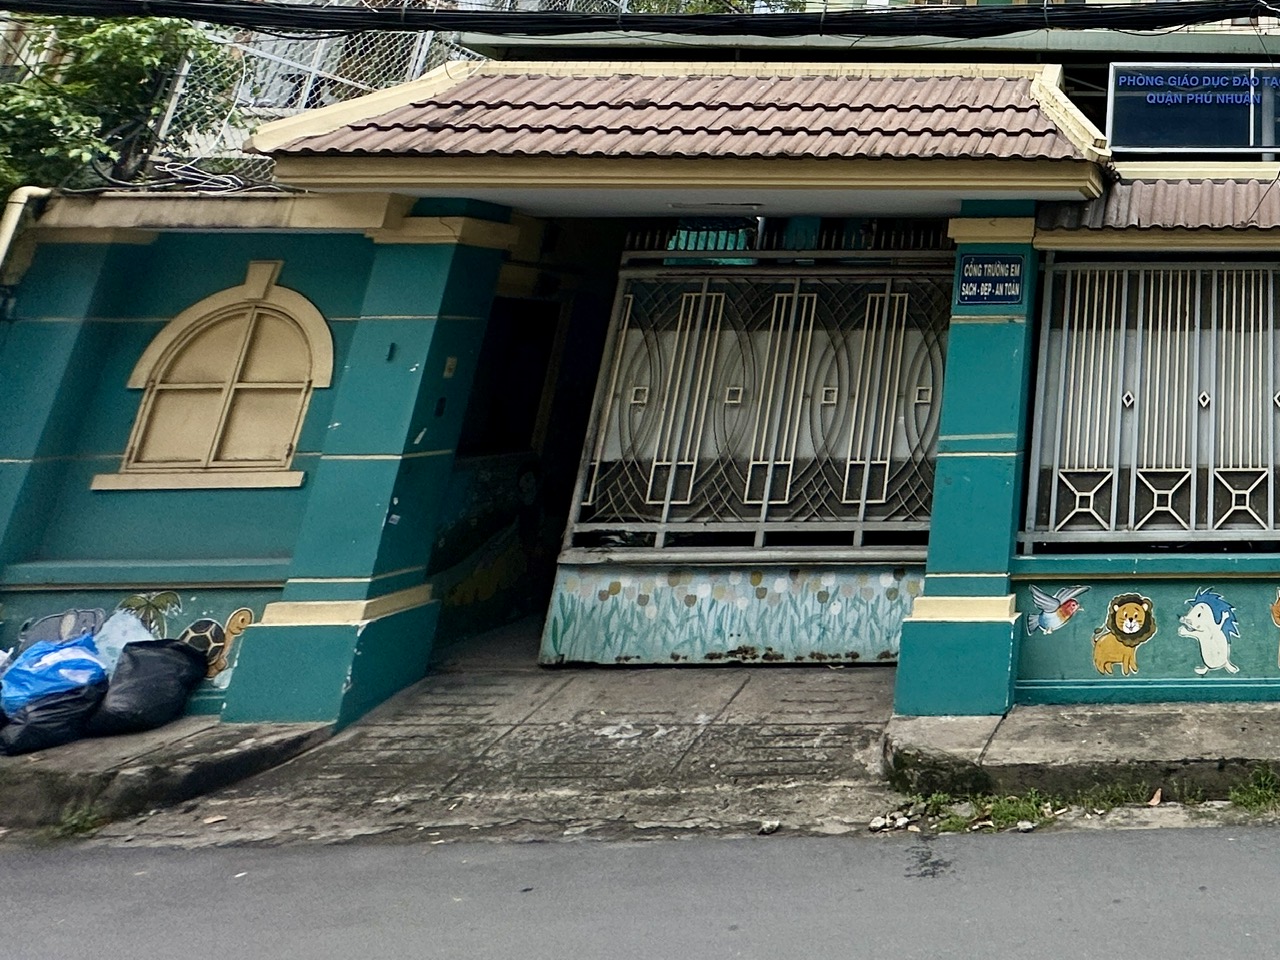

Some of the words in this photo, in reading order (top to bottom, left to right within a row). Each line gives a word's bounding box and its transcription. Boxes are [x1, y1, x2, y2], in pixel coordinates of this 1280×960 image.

[1118, 73, 1164, 86] PHÒNG
[1167, 73, 1199, 86] GIÁO
[1202, 76, 1229, 88] DỤC
[1232, 73, 1259, 86] ĐÀO
[1146, 91, 1182, 105] QUẬN
[1186, 91, 1212, 104] PHÚ
[1216, 91, 1261, 105] NHUẬN
[1010, 263, 1020, 277] EM
[995, 283, 1003, 295] AN
